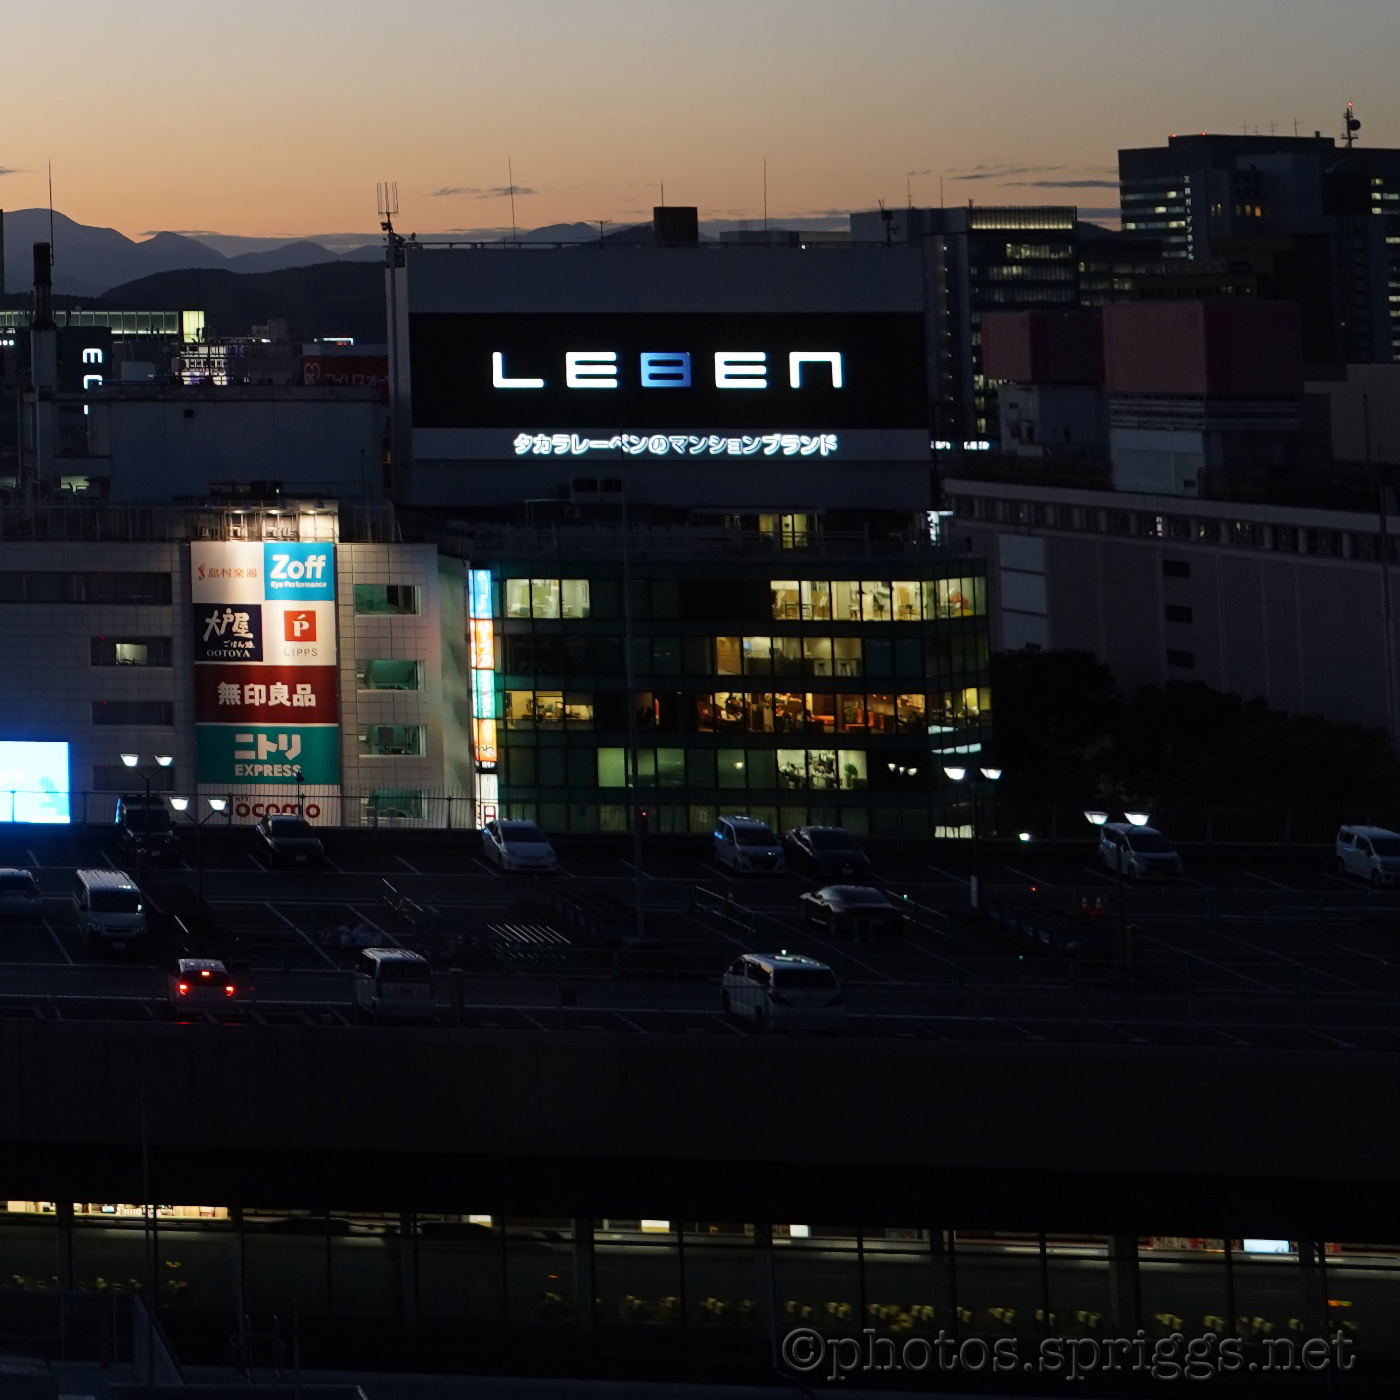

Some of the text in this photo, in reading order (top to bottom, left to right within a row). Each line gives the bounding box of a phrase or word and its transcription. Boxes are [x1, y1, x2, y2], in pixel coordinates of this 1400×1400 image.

[513, 433, 838, 456] タカラレーベンのマンションブランド
[208, 567, 257, 579] 島村楽器
[270, 554, 327, 579] Zoff
[270, 581, 283, 589] Eye
[203, 607, 254, 641] 大戸屋
[206, 649, 251, 658] OOTOYA
[283, 648, 319, 657] LIPPS
[217, 681, 317, 707] 無印良品
[234, 733, 302, 760] ニトリ
[234, 764, 302, 777] EXPRESS
